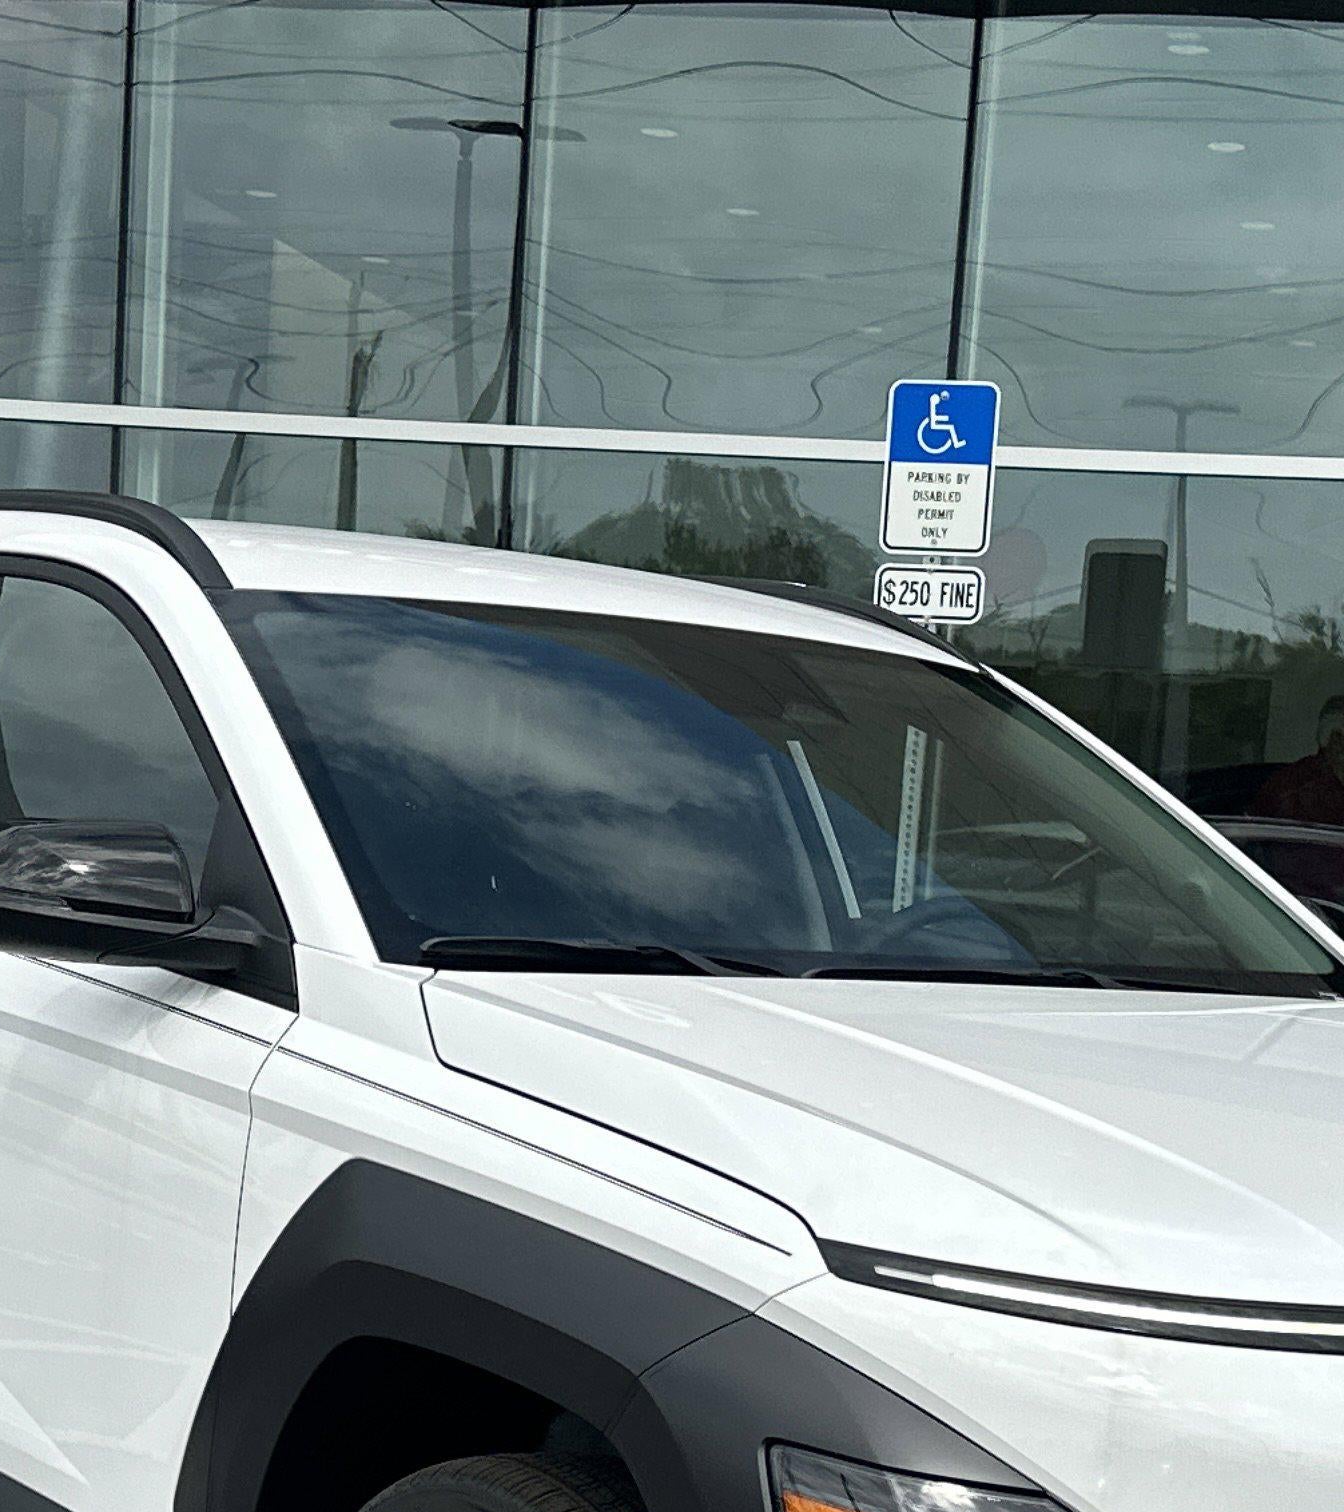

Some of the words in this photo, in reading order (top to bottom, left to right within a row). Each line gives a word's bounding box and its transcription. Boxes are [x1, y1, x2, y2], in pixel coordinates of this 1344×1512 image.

[906, 471, 952, 484] PARKING
[956, 473, 970, 484] BY
[913, 490, 961, 503] DISABLED
[918, 508, 954, 520] PERMIT
[921, 526, 948, 538] ONLY
[882, 578, 931, 607] $250
[939, 582, 976, 608] FINE
